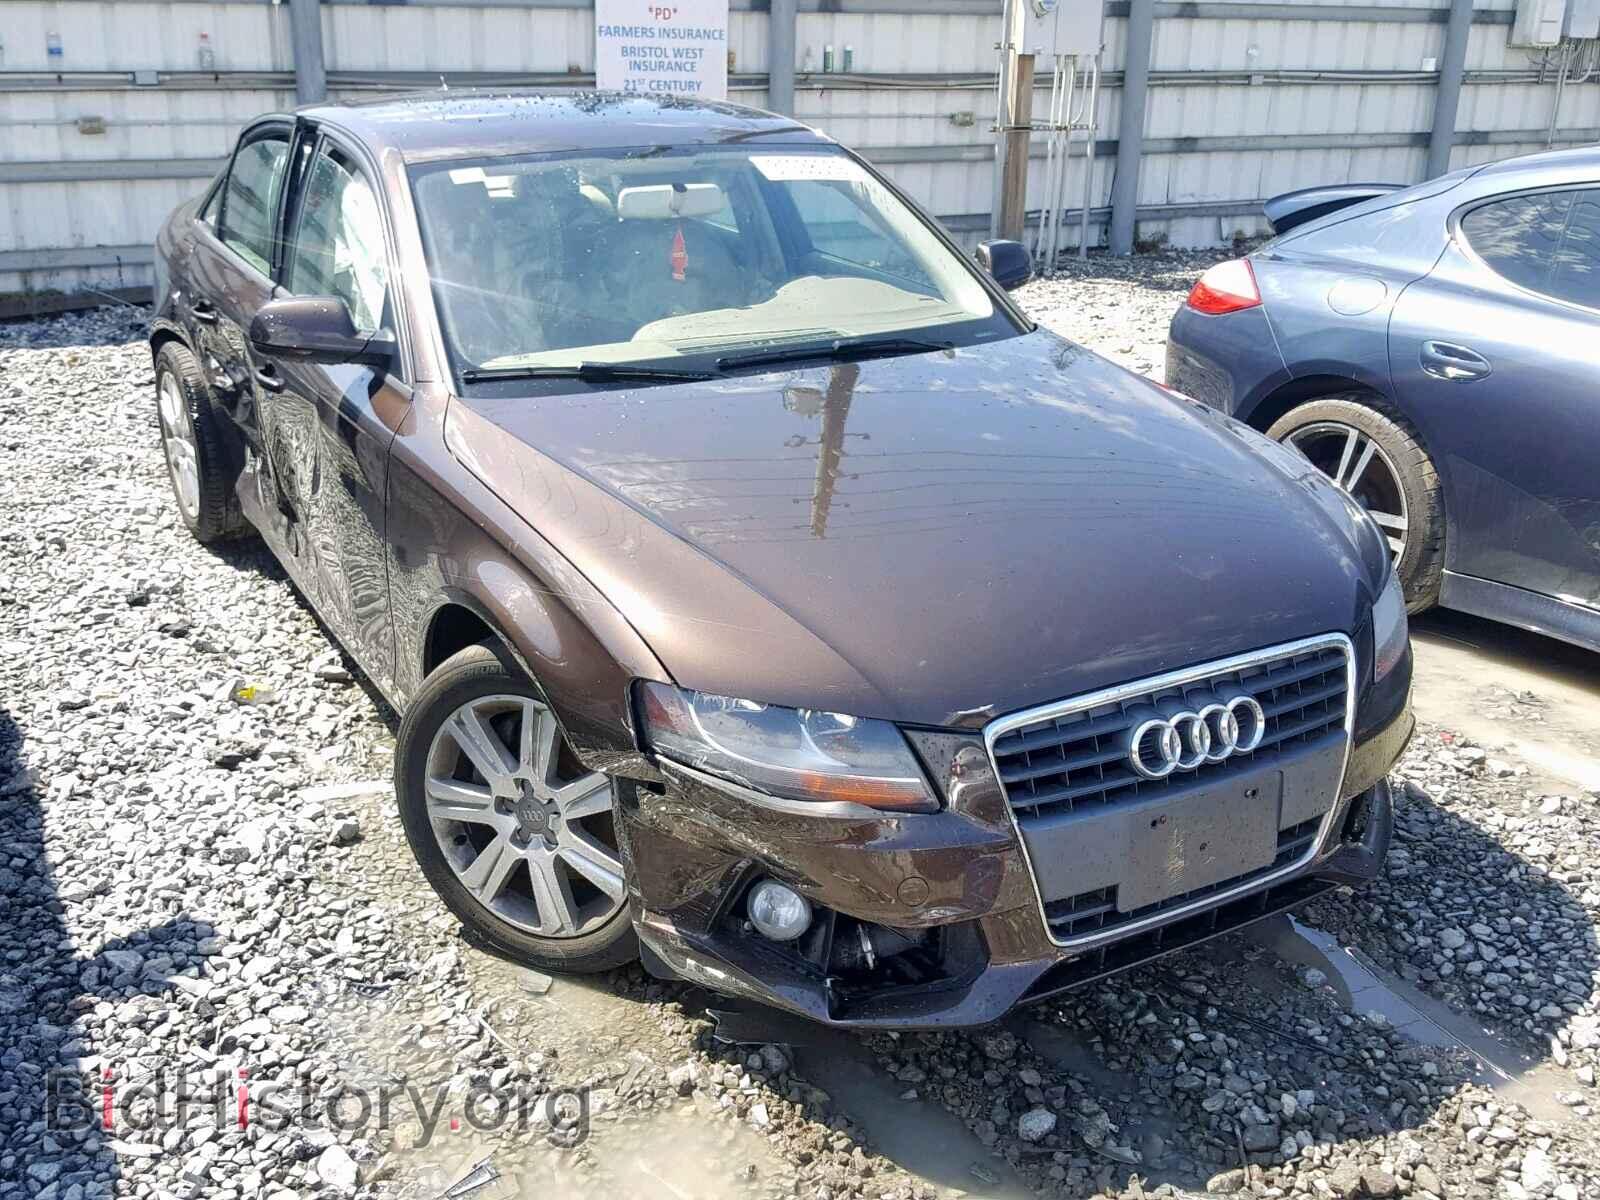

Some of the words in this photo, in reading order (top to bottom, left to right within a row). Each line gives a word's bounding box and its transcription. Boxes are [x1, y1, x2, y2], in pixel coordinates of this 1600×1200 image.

[598, 25, 656, 39] FARMERS
[658, 27, 726, 41] INSURANCE
[621, 46, 670, 59] BRISTOL
[672, 47, 705, 60] WEST
[629, 60, 697, 73] INSURANCE
[649, 79, 702, 92] CENTURY
